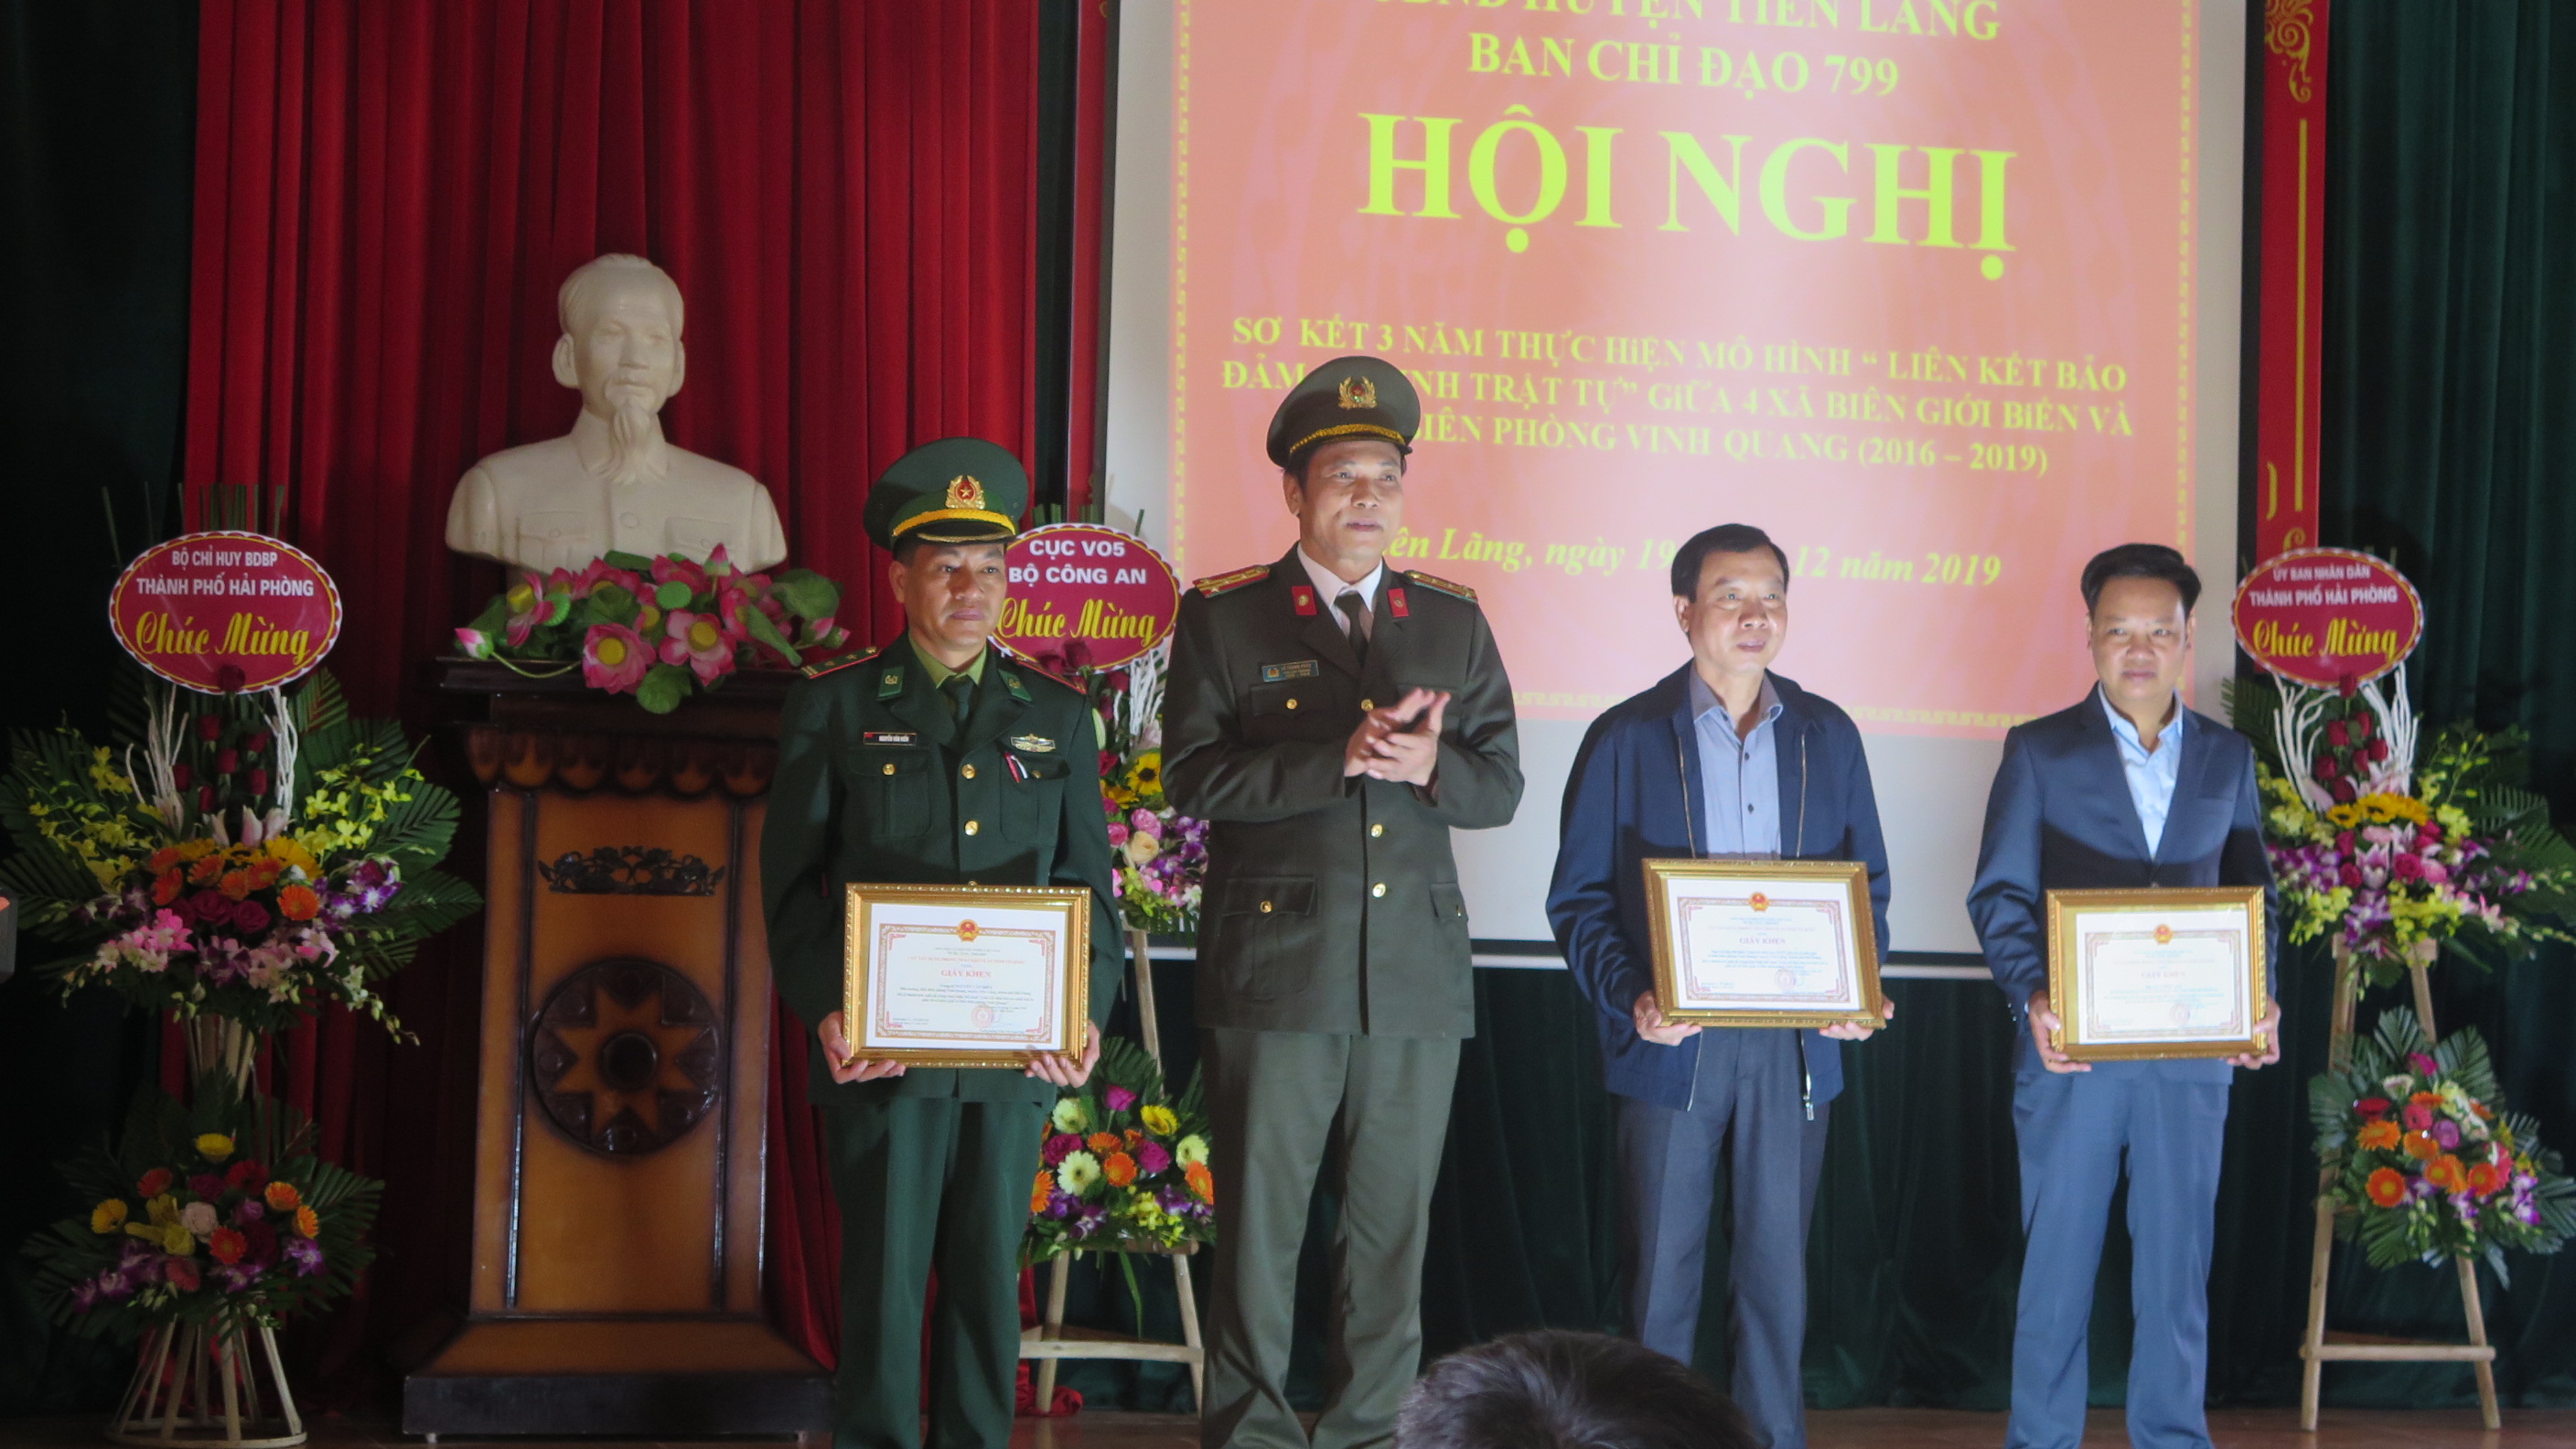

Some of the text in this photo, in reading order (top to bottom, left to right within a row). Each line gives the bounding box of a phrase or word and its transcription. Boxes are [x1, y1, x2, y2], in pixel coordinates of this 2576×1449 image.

[1467, 32, 1899, 100] BAN CHỈ ĐẠO 799
[1357, 103, 2017, 281] HỘI NGHỊ
[1233, 317, 1283, 345] SƠ
[1299, 314, 1368, 349] KẾT
[1376, 324, 1393, 351] 3
[1404, 322, 1484, 357] NĂM
[1496, 329, 1596, 368] THỰC
[1696, 335, 1754, 370] MÔ
[1764, 338, 1852, 377] HÌNH
[1888, 345, 1968, 382] LIÊN
[1979, 350, 2047, 387] KẾT
[2056, 354, 2127, 392] BẢO
[1222, 352, 1306, 390] ĐẢM
[1470, 372, 1562, 410] TRẬT
[1743, 388, 1759, 415] 4
[1768, 384, 1815, 418] XÃ
[1827, 386, 1909, 422] BIÊN
[1916, 392, 1991, 428] GIỚI
[2088, 401, 2132, 435] VÀ
[1413, 405, 1484, 443] IÊN
[1493, 413, 1616, 451] PHÒNG
[1627, 424, 1712, 456] VINH
[1723, 428, 1849, 463] QUANG
[1858, 436, 1937, 468] (2016
[1970, 441, 2048, 478] 2019)
[172, 548, 189, 570] BỘ
[191, 544, 214, 566] CHỈ
[216, 552, 242, 566] HUY
[1008, 563, 1146, 587] BỘ CÔNG AN
[1029, 540, 1075, 560] CỤC
[1381, 527, 2002, 586] ên Lãng, ngày 19 12 năm 2019
[2291, 567, 2313, 581] BAN
[137, 572, 314, 596] THÀNH PHỐ HẢI PHÒNG
[2249, 582, 2399, 606] THÀNH PHỐ HẢI PHÒNG
[136, 611, 310, 665] Chúc Mừng
[997, 597, 1157, 647] Chúc Mừng
[2253, 617, 2398, 663] Chúc Mừng
